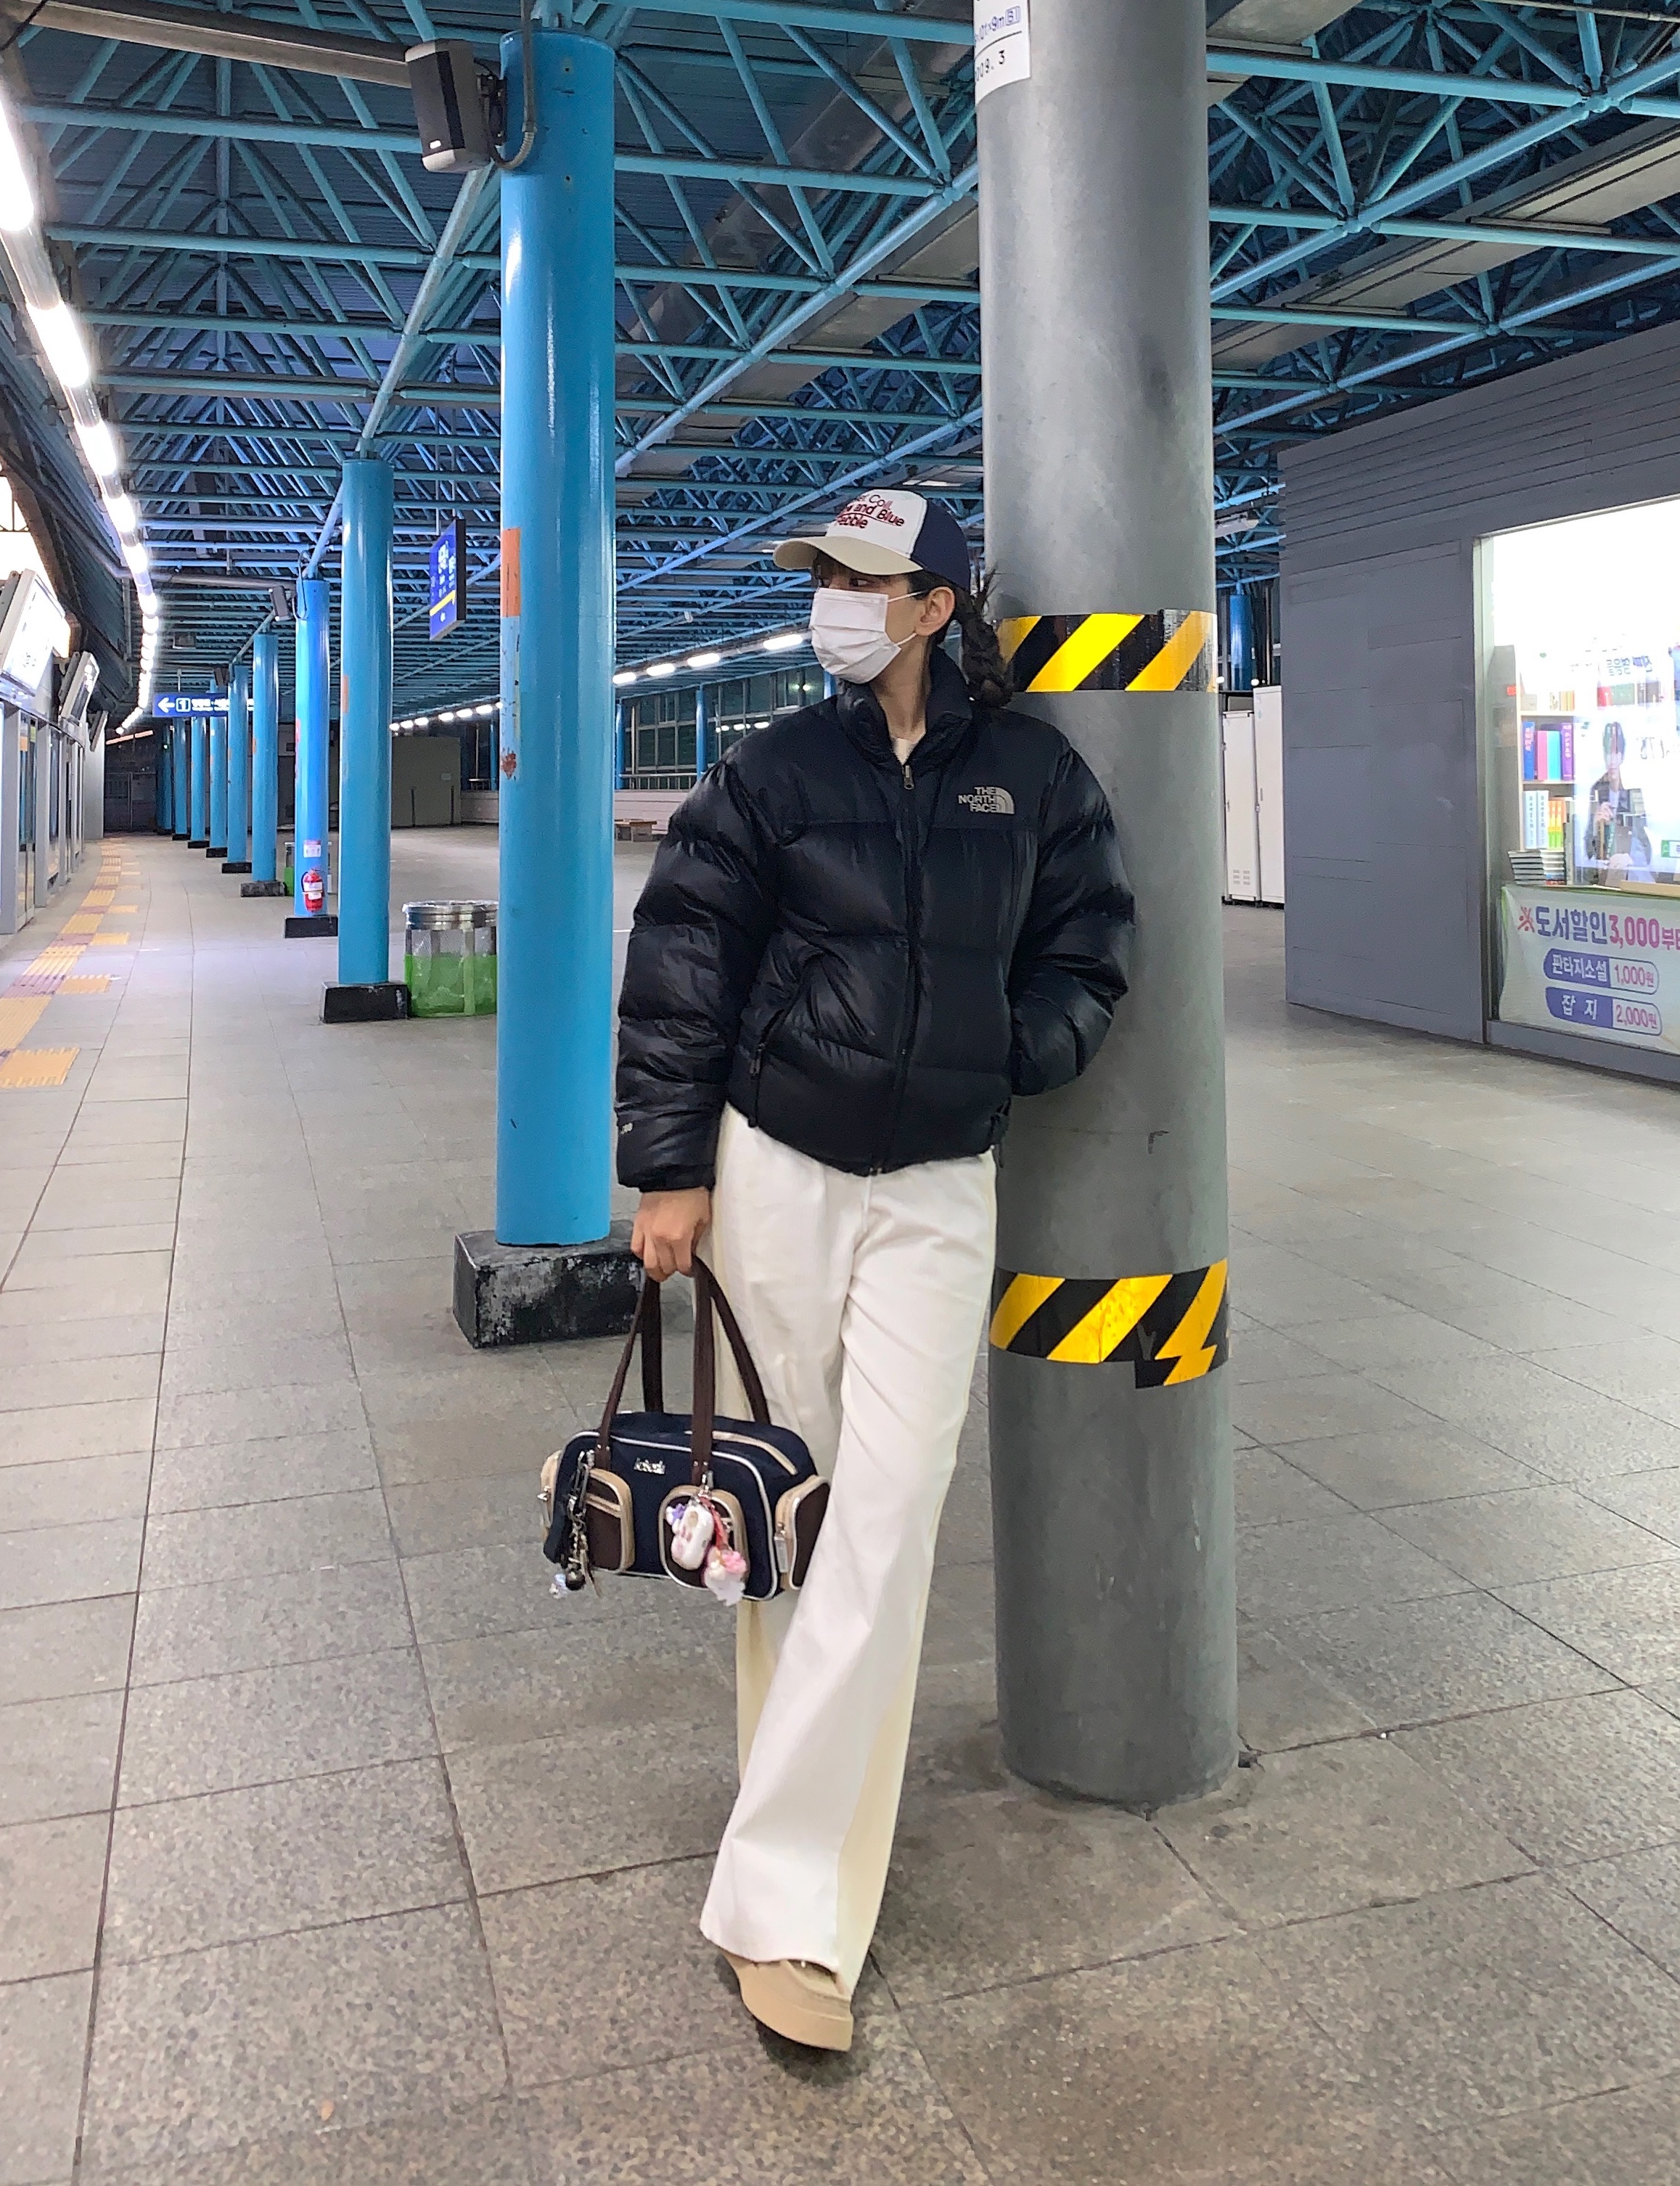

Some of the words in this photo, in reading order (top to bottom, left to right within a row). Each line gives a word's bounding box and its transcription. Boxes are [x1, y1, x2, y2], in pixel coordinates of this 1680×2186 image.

[877, 509, 905, 527] Blue
[958, 795, 995, 803] NORTH
[970, 803, 999, 813] FACE
[1535, 905, 1608, 944] 도서할인
[1552, 954, 1607, 982] 판타지소설
[1614, 964, 1655, 988] 1,000원
[1615, 1004, 1658, 1029] 2,000원
